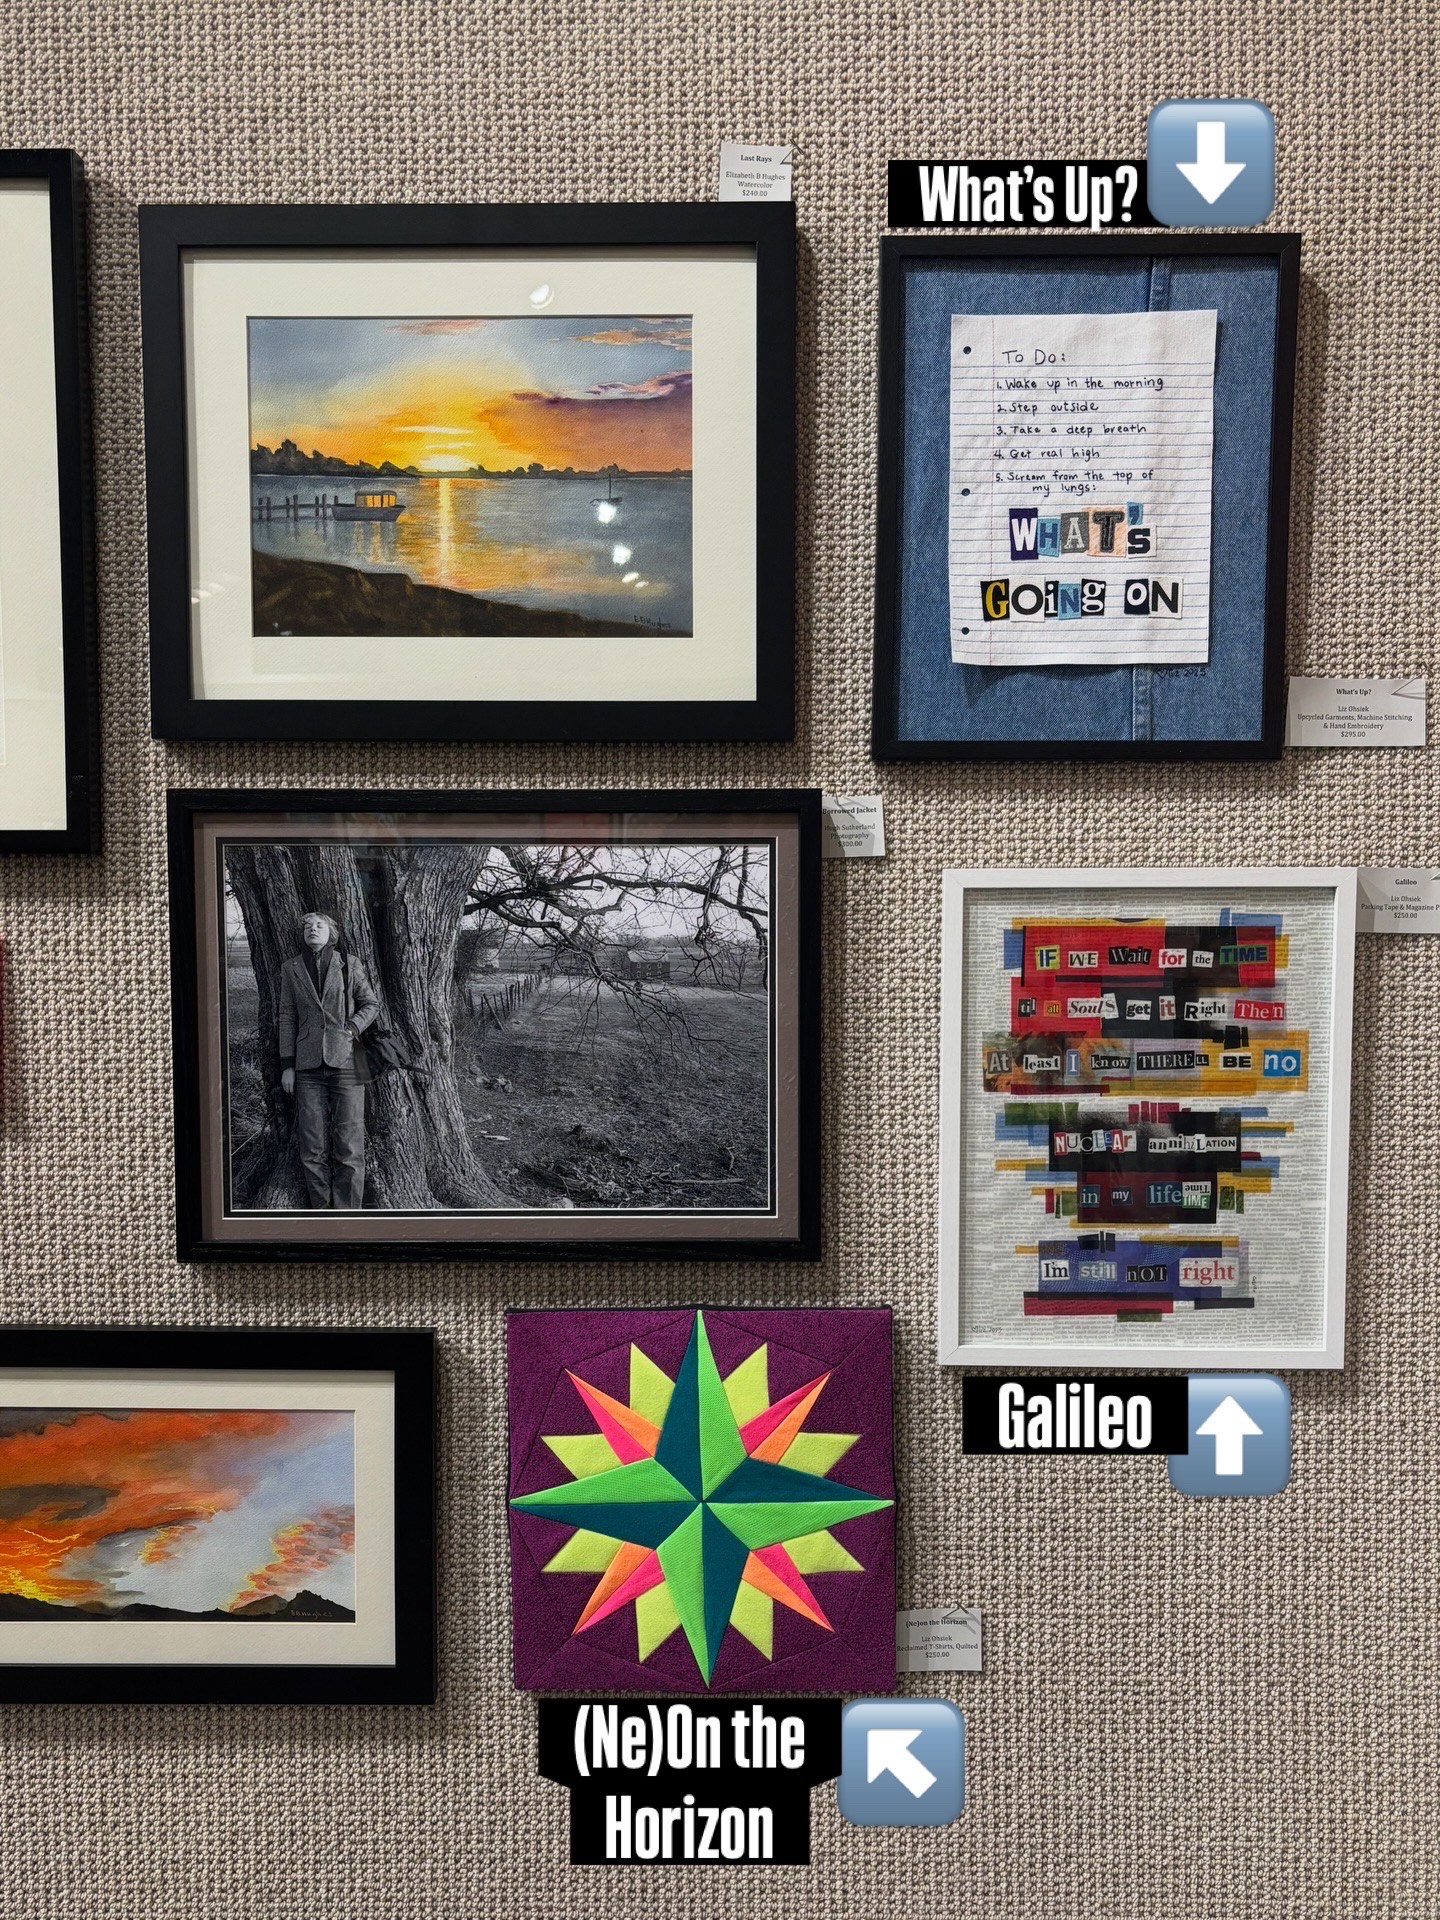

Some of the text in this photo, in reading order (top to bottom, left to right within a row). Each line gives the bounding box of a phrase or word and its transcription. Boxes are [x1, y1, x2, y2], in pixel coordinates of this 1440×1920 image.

[756, 155, 772, 163] Rays
[726, 171, 755, 179] Elizabeth
[762, 173, 786, 181] Hughes
[1002, 349, 1066, 365] To Do:
[1047, 382, 1061, 394] up
[1067, 378, 1078, 388] in
[1084, 377, 1104, 388] the
[1114, 377, 1164, 391] morning
[1051, 401, 1099, 412] outside
[1010, 426, 1041, 434] Take
[1066, 425, 1093, 438] deep
[1103, 424, 1146, 433] breath
[1010, 449, 1032, 458] Get
[1041, 448, 1062, 457] real
[1072, 448, 1100, 462] high
[1007, 472, 1046, 481] Scream
[1052, 470, 1078, 481] from
[1084, 470, 1104, 481] the
[1112, 470, 1132, 484] top
[1142, 469, 1154, 480] of
[1032, 483, 1096, 497] my lungs:
[831, 832, 869, 840] Photography
[1040, 947, 1267, 967] IF WE Wait for the TIME
[1047, 1004, 1059, 1013] all
[1126, 1003, 1150, 1017] get
[1160, 999, 1175, 1016] it
[1185, 1001, 1226, 1019] Right
[990, 1052, 1009, 1072] At
[1025, 1056, 1059, 1070] least
[1091, 1057, 1129, 1068] know
[1223, 1056, 1251, 1068] BE
[1265, 1052, 1297, 1072] no
[1082, 1189, 1098, 1204] in
[1112, 1190, 1129, 1202] my
[1044, 1262, 1068, 1278] I'm
[1081, 1264, 1116, 1279] still
[1182, 1260, 1235, 1285] right
[906, 1620, 928, 1628] (Ne)on
